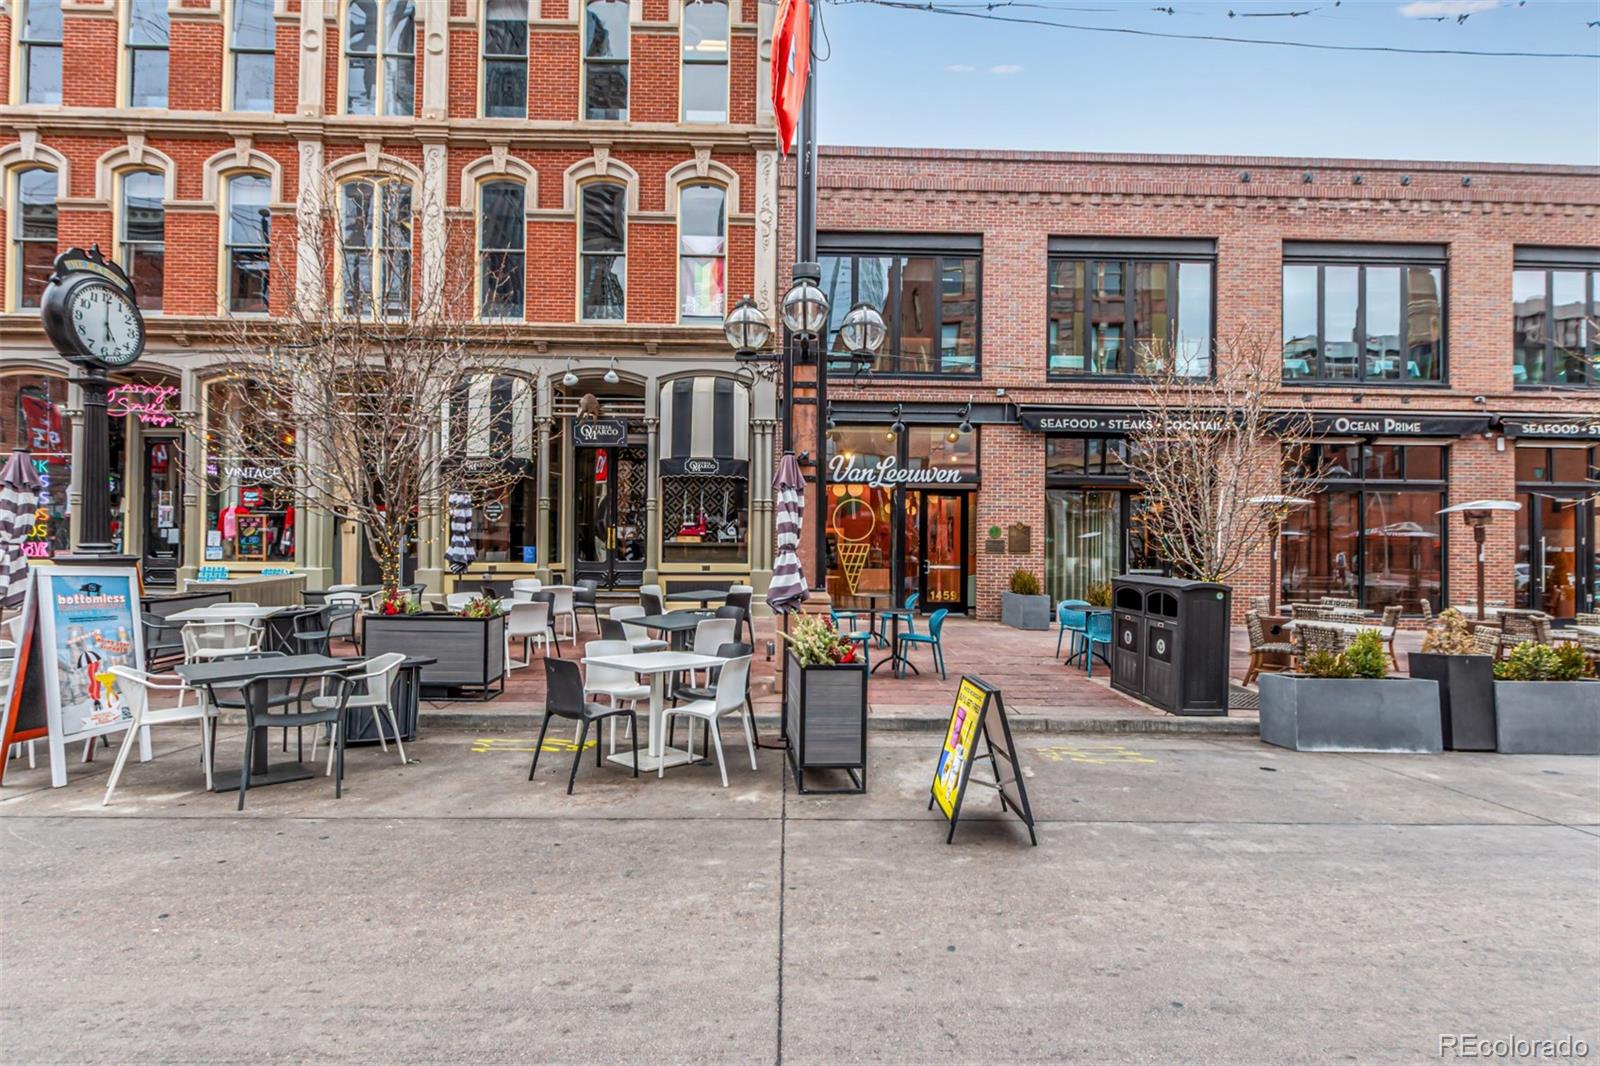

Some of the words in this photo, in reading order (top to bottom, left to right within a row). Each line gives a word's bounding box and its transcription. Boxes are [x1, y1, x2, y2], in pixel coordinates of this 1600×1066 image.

[90, 292, 98, 302] 11
[80, 298, 91, 309] 10
[74, 310, 83, 320] 9
[124, 314, 132, 325] 2
[78, 325, 86, 336] 8
[127, 328, 136, 339] 3
[87, 338, 95, 348] 7
[122, 342, 131, 351] 4
[100, 346, 108, 359] 6
[113, 347, 121, 357] 5
[1040, 418, 1098, 429] SEAFOOD
[1108, 419, 1153, 430] STEAKS
[1384, 418, 1421, 433] PRIME
[1521, 423, 1579, 434] SEAFOOD
[584, 428, 619, 440] MARCO
[828, 454, 875, 482] Van
[870, 455, 962, 488] Leeuwen
[57, 594, 126, 605] bottomless
[930, 590, 957, 600] 1459
